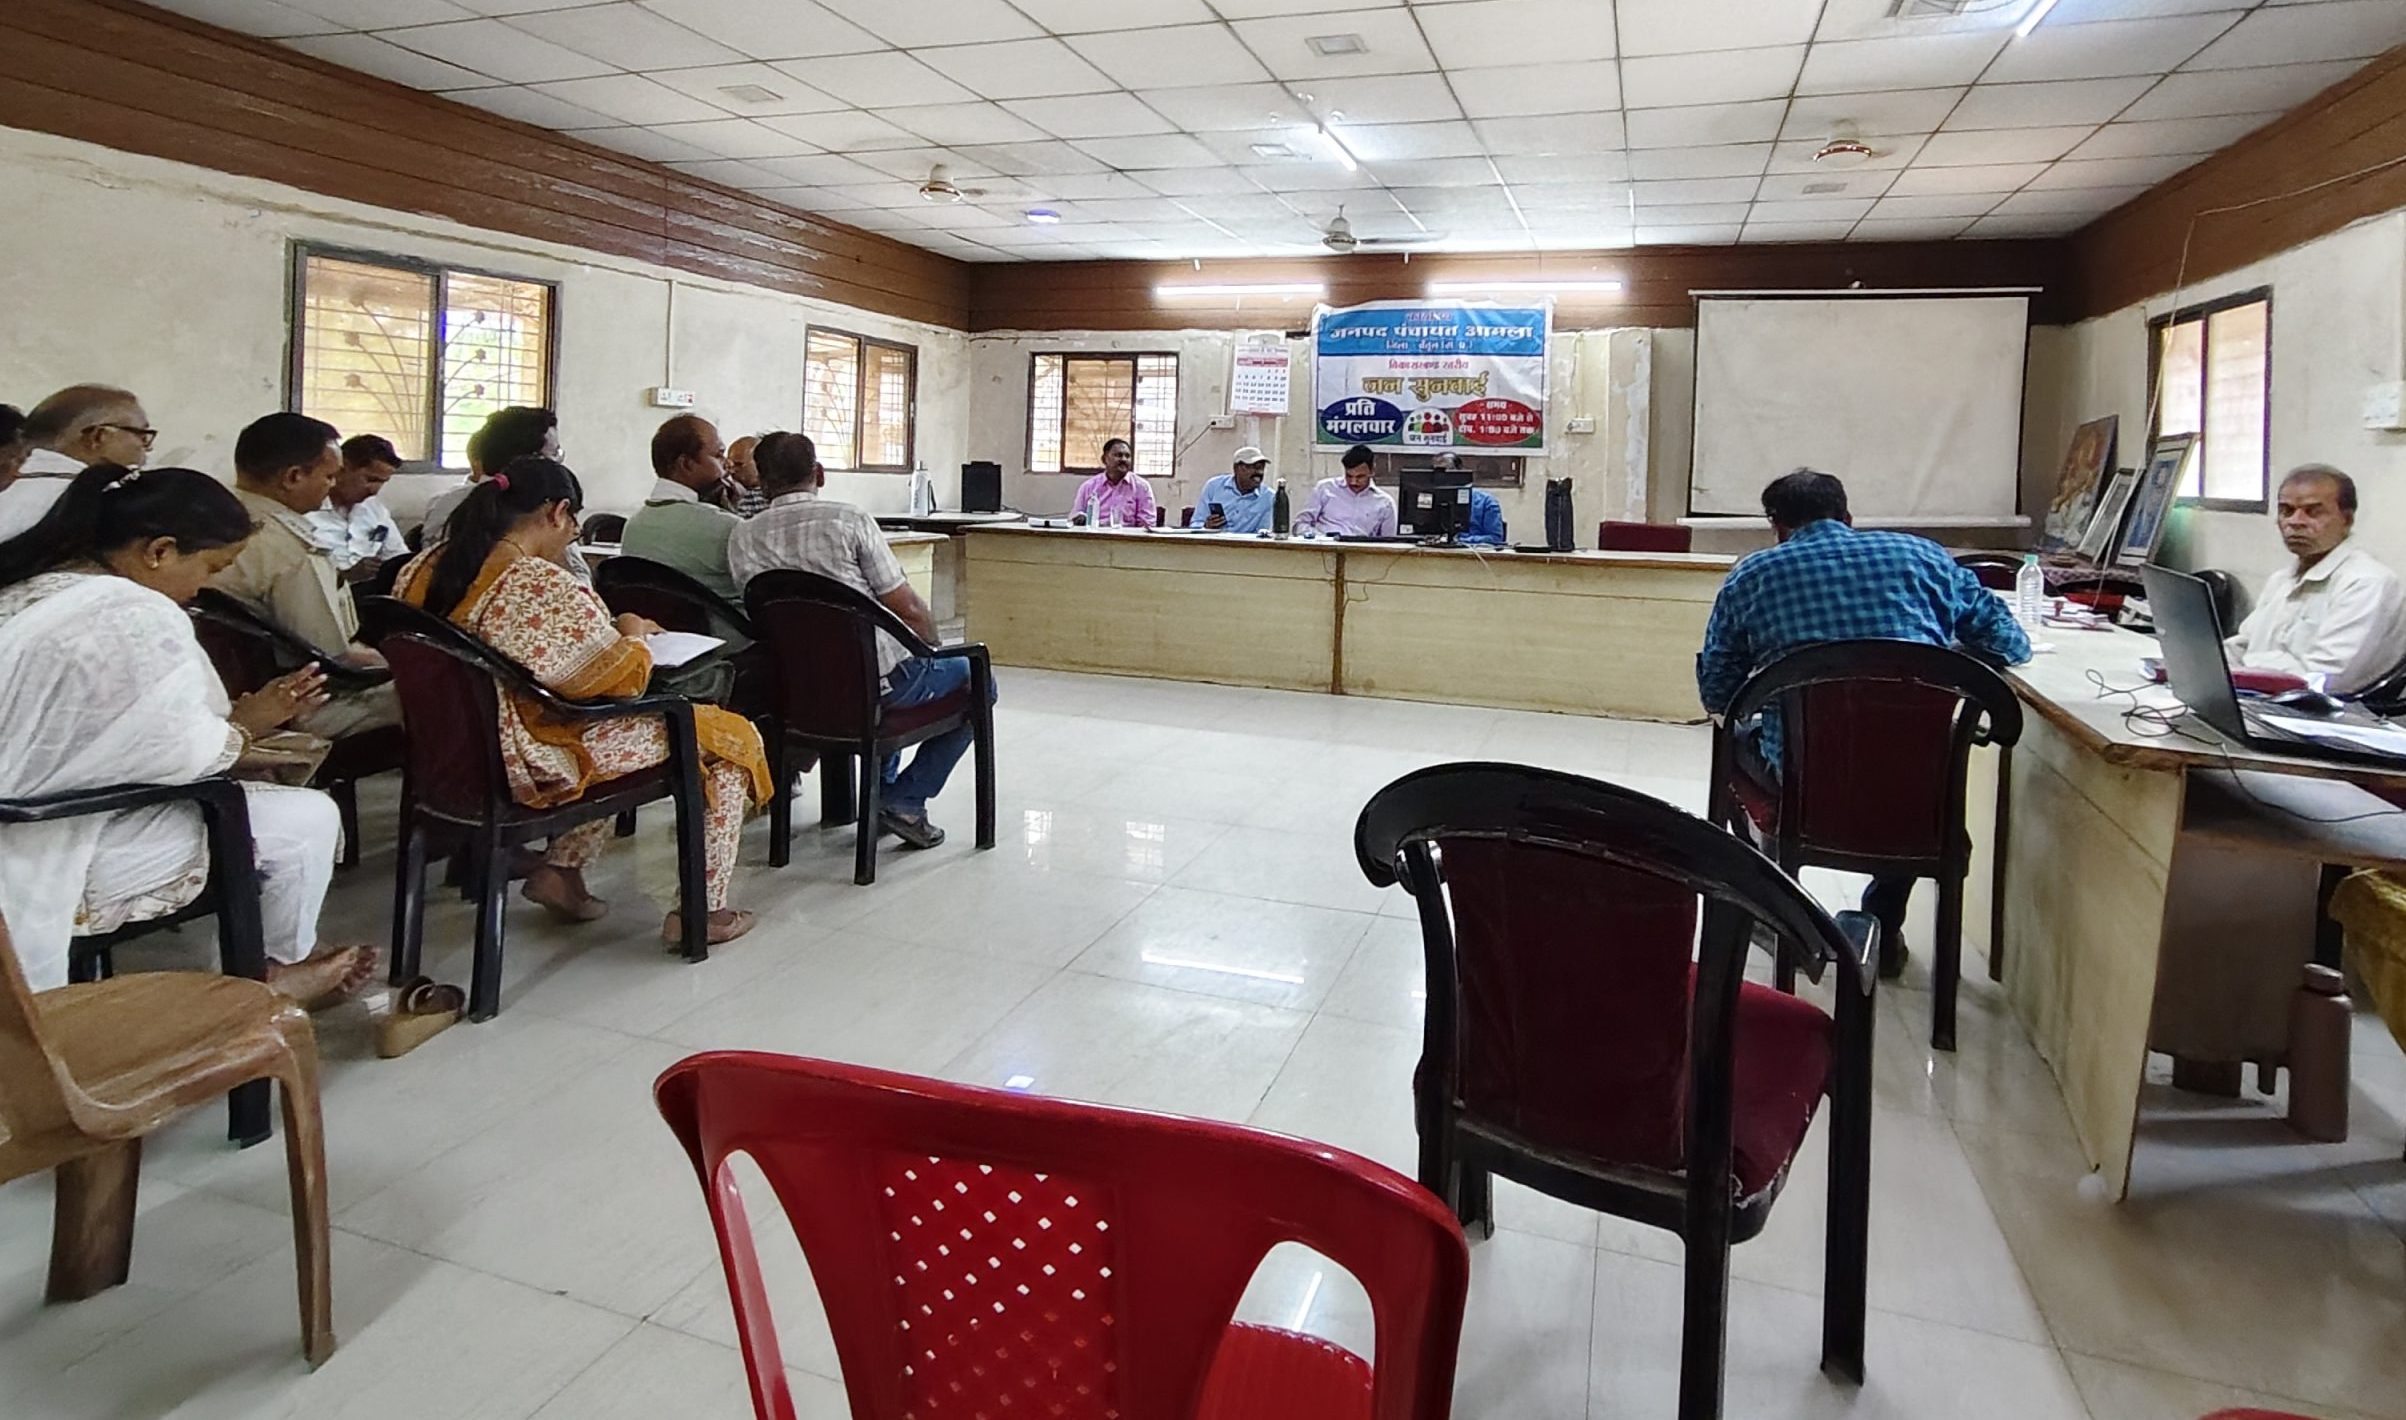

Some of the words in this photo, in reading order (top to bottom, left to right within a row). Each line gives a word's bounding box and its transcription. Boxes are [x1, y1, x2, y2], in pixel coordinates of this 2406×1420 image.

[1330, 326, 1389, 339] जनपद
[1393, 322, 1458, 338] पंचायत
[1465, 325, 1534, 341] आमला
[1363, 377, 1404, 396] जन
[1408, 370, 1489, 402] सुनवाई
[1345, 399, 1376, 416] प्रति
[1326, 415, 1396, 434] मंगलवार
